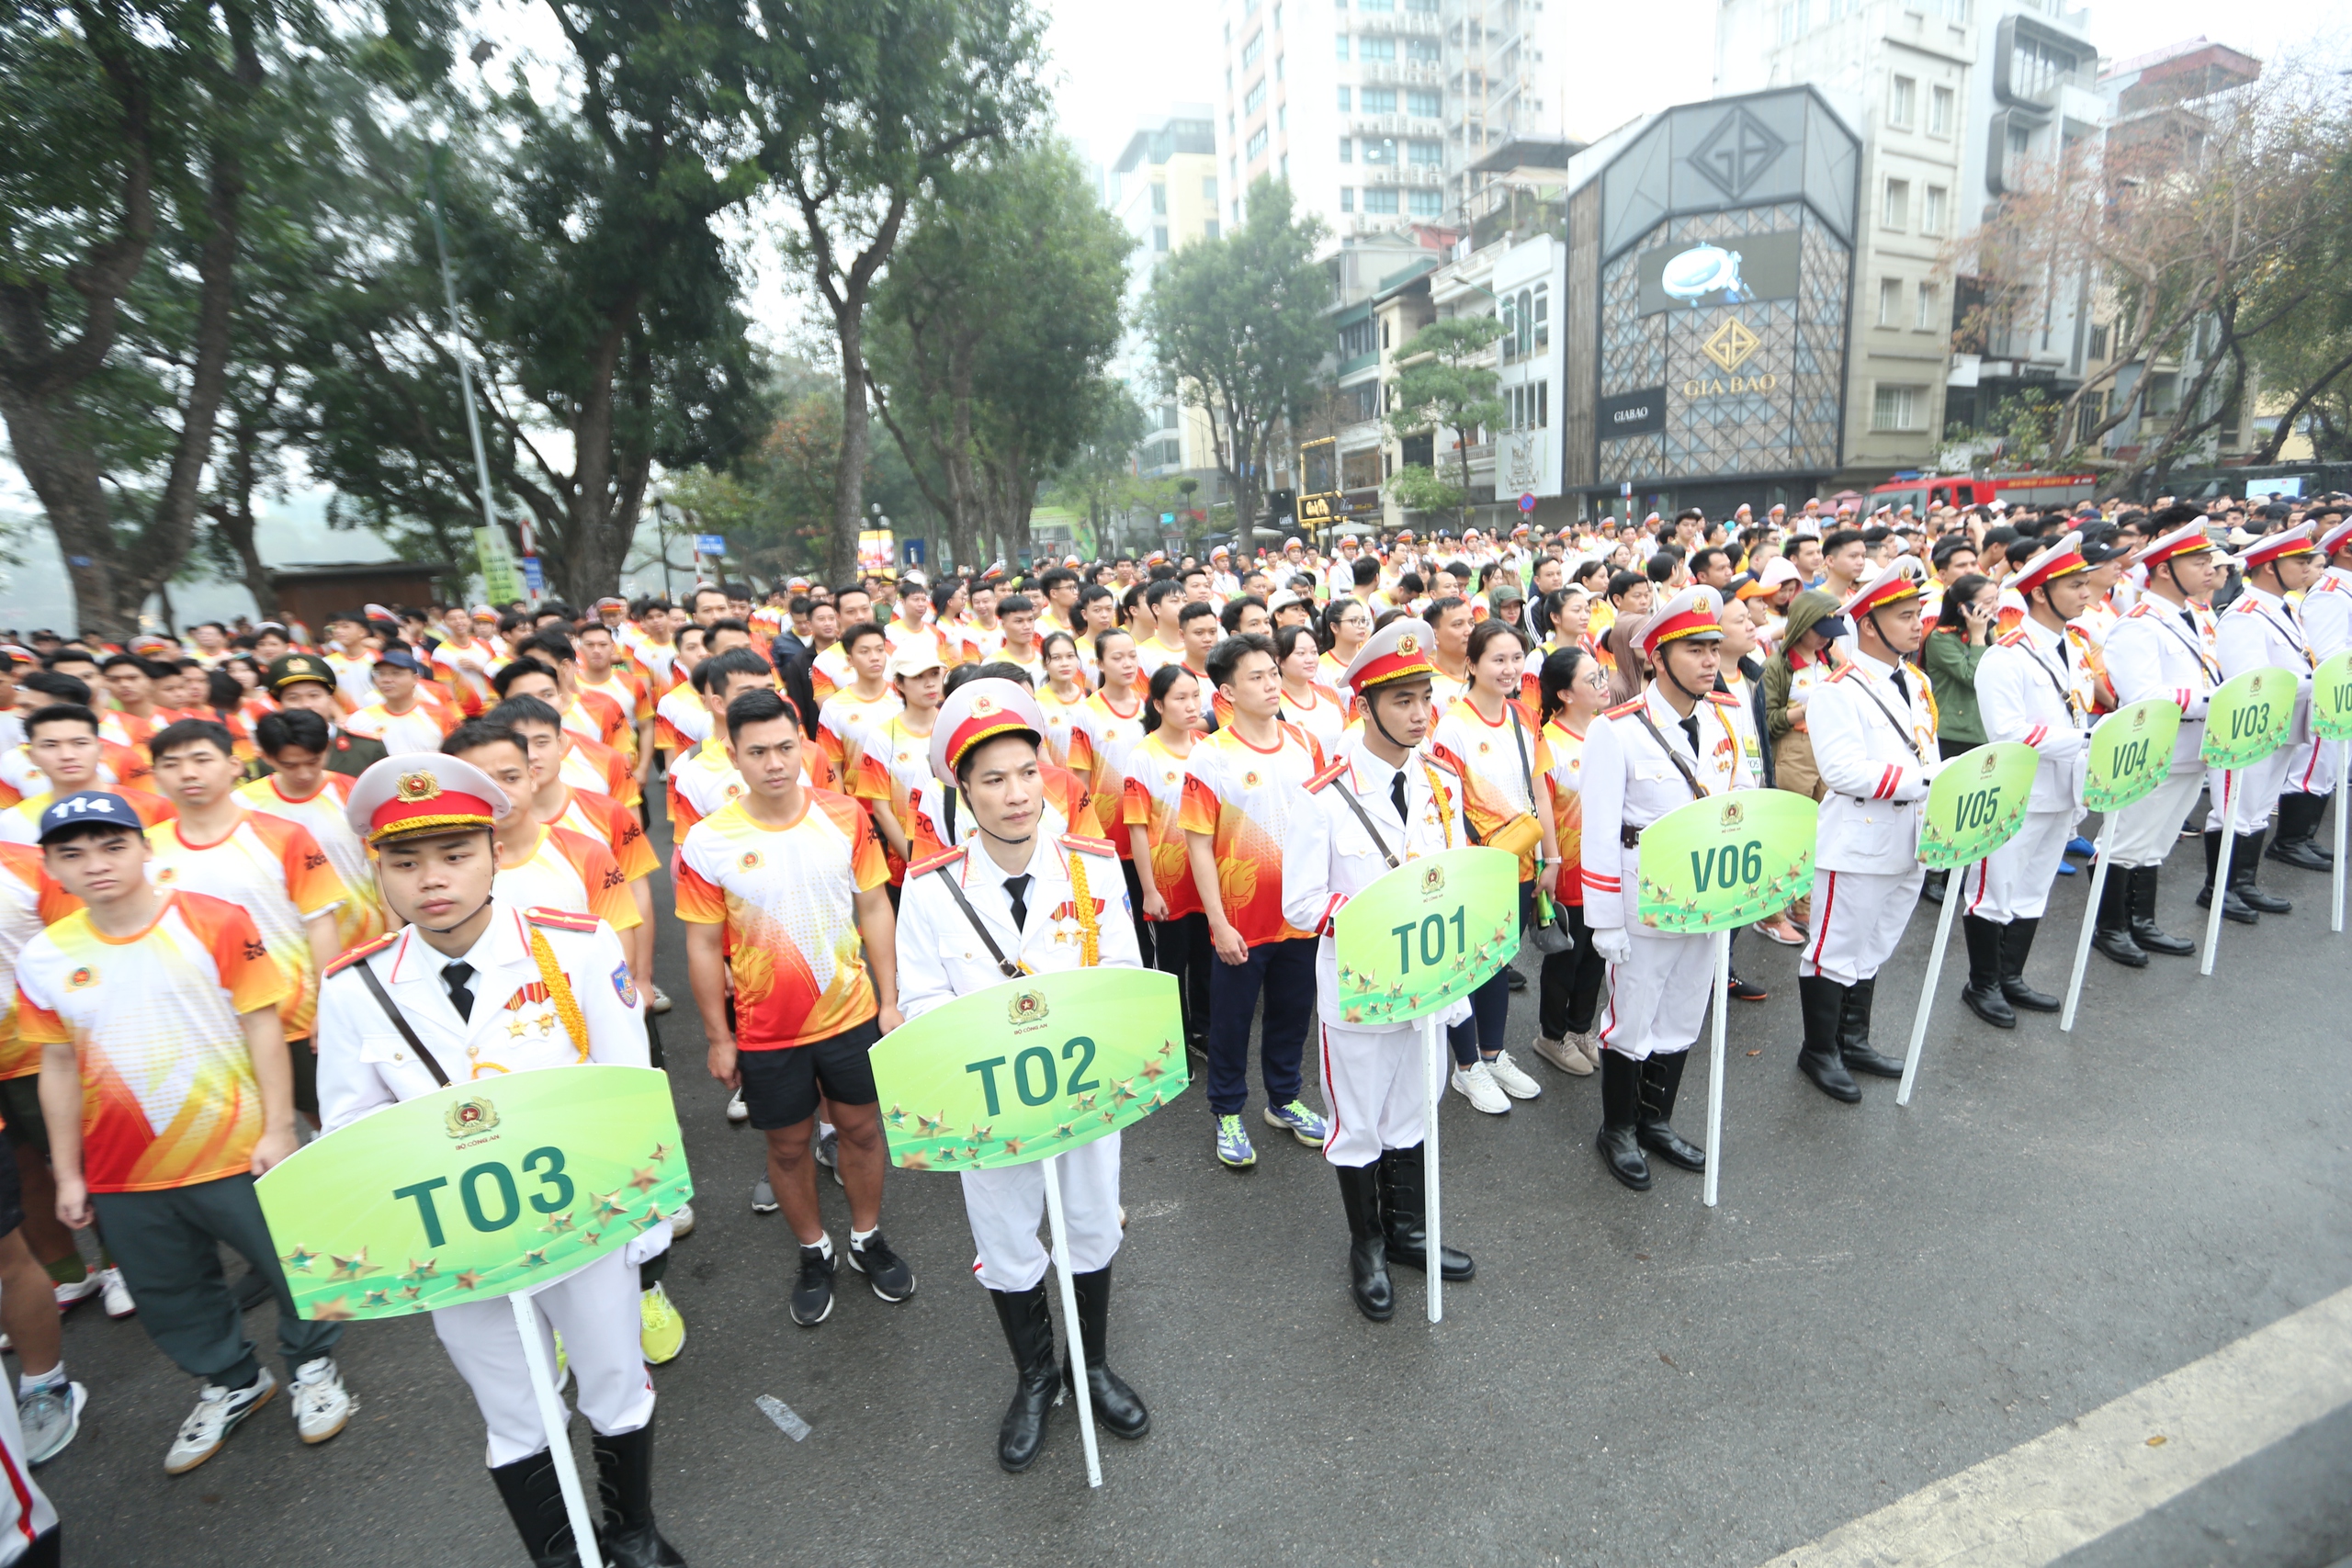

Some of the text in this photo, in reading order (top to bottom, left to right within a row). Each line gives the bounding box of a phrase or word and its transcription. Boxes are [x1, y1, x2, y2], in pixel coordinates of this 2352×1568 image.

[1684, 374, 1777, 398] GIA BAO
[1613, 406, 1648, 423] GIABAO
[2232, 702, 2270, 739] V03
[2112, 738, 2150, 780] V04
[51, 796, 115, 818] 114
[1955, 785, 2001, 832] V05
[1690, 840, 1762, 893] V06
[1392, 905, 1465, 976] T01
[965, 1036, 1101, 1118] T02
[392, 1145, 575, 1249] T03
